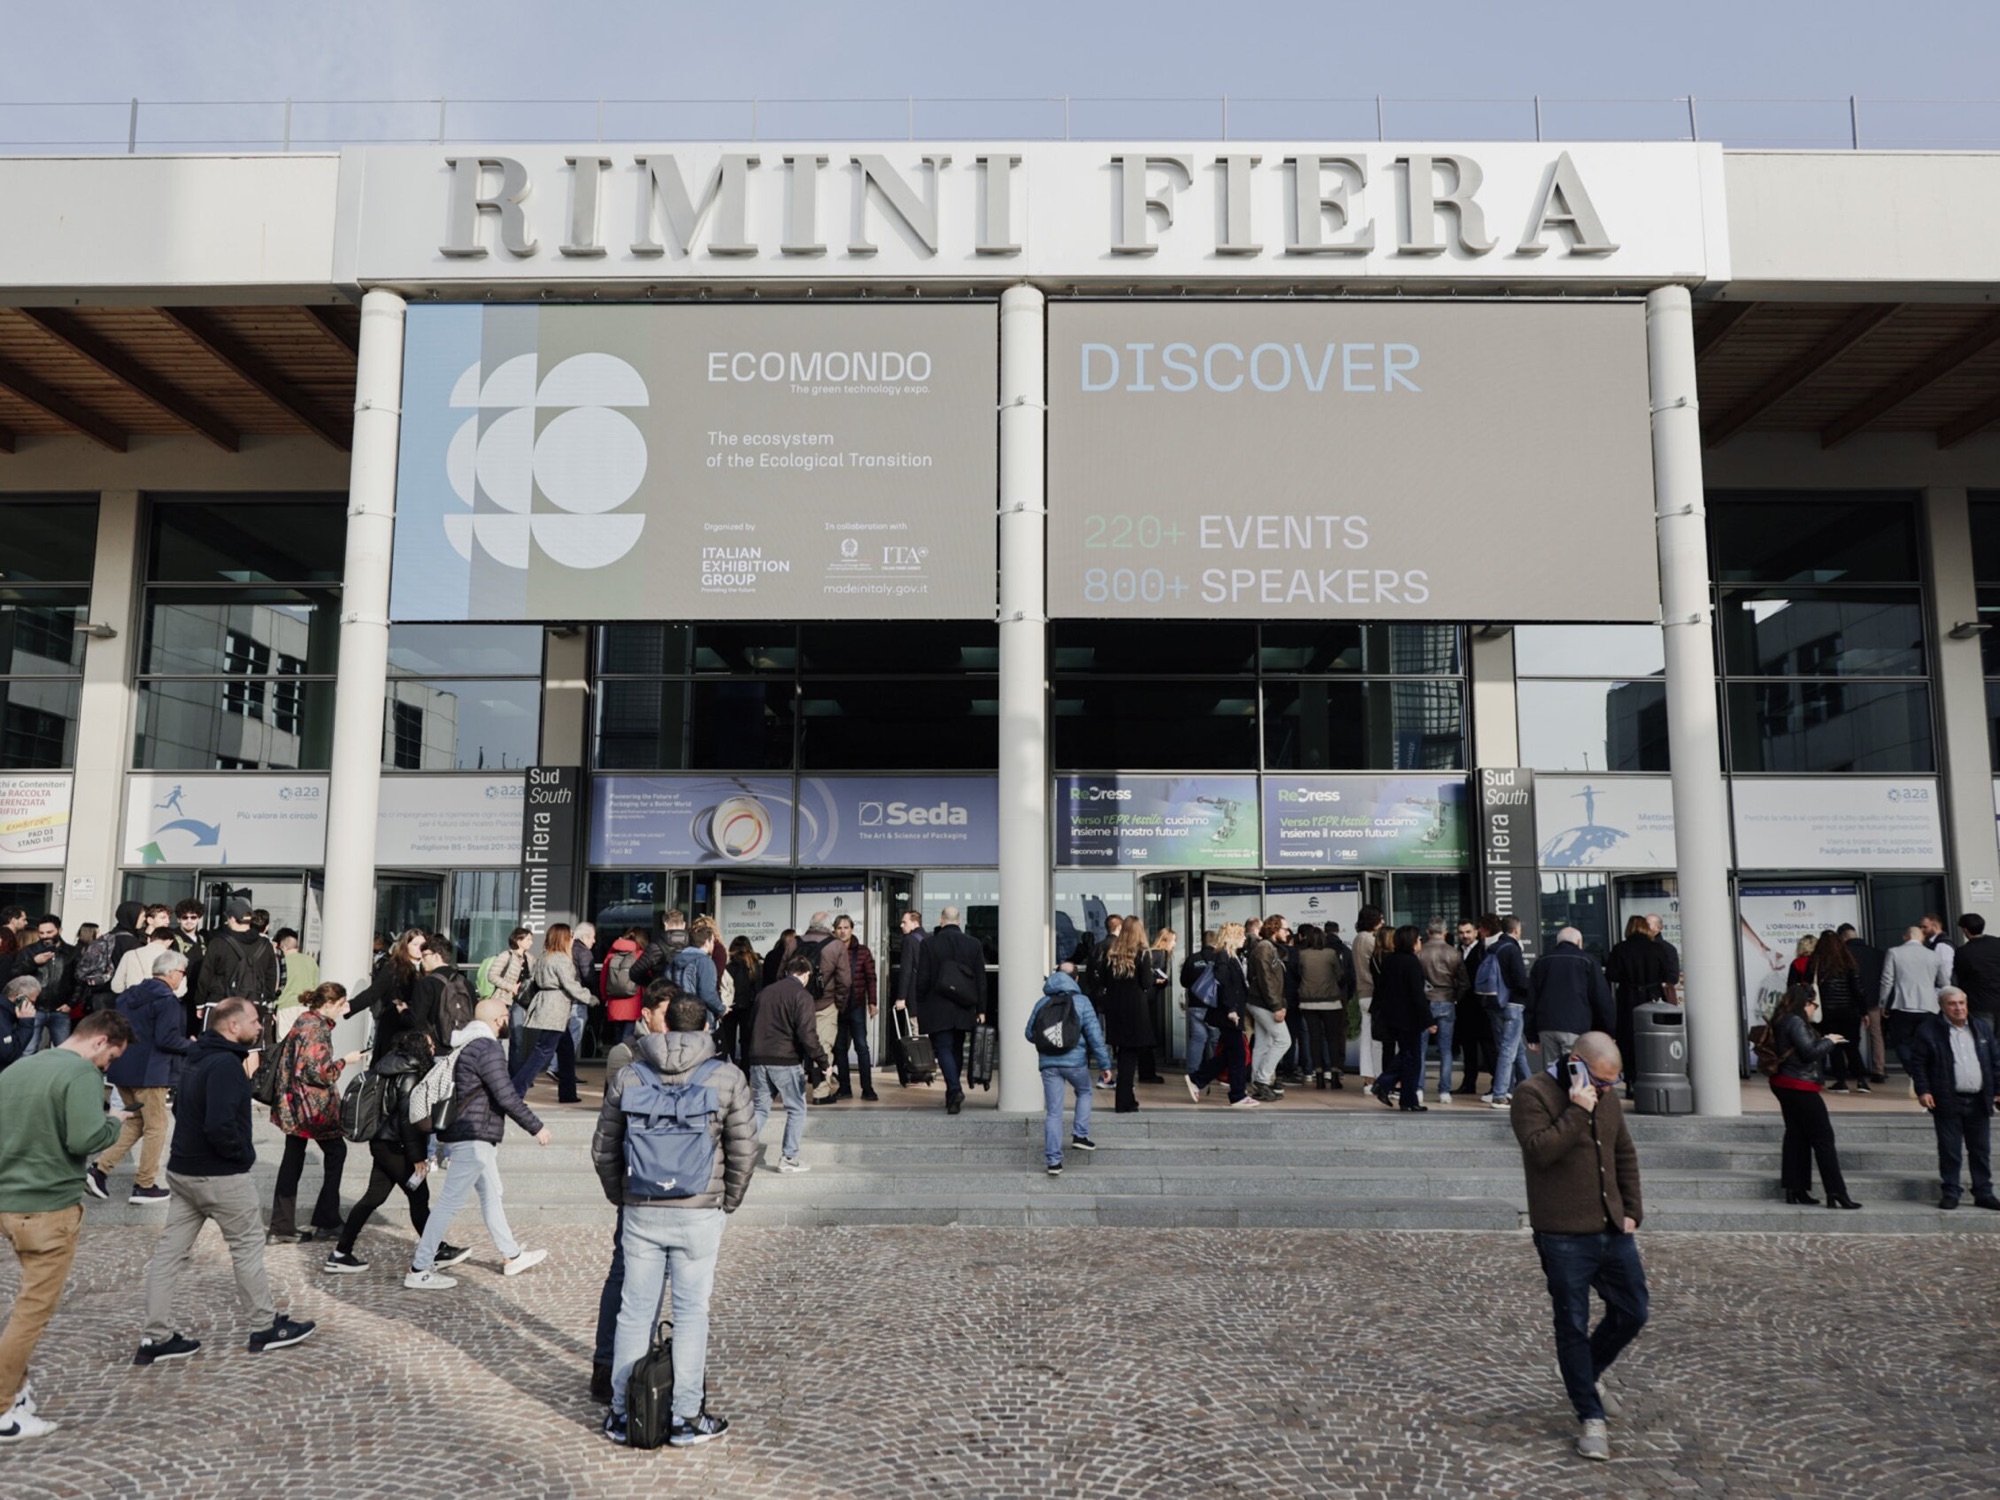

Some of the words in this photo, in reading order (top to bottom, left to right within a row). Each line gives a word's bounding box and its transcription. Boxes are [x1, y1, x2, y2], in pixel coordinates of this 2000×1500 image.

[439, 154, 1022, 258] RIMINI
[1109, 150, 1621, 257] FIERA
[708, 351, 931, 382] ECOMONDO
[1081, 342, 1422, 392] DISCOVER
[791, 384, 809, 394] The
[812, 386, 841, 396] green
[844, 384, 901, 397] technology
[904, 386, 931, 396] expo.
[707, 431, 738, 445] The
[743, 433, 834, 449] ecosystem
[706, 453, 722, 467] of
[727, 453, 754, 467] the
[760, 452, 844, 471] Ecological
[849, 452, 932, 467] Transition
[704, 523, 743, 532] Organized
[745, 523, 756, 532] by
[1084, 514, 1187, 549] 220+
[1199, 515, 1369, 549] EVENTS
[702, 547, 761, 559] ITALIAN
[882, 546, 921, 564] ITA
[702, 560, 790, 572] EXHIBITION
[701, 573, 756, 586] GROUP
[1084, 567, 1188, 603] 800+
[1201, 568, 1430, 604] SPEAKERS
[824, 584, 928, 596] madeinitaly.gov.it
[530, 768, 560, 784] Sud
[1484, 769, 1515, 786] Sud
[18, 780, 66, 789] Contenitori
[8, 789, 51, 798] RACCOLTA
[294, 786, 320, 797] a2a
[529, 787, 572, 804] South
[1485, 788, 1529, 805] South
[1903, 788, 1929, 799] a2a
[0, 807, 28, 815] RIFIUTI
[237, 811, 250, 820] Più
[253, 812, 278, 820] valore
[289, 812, 318, 820] circolo
[886, 801, 968, 826] Seda
[1071, 816, 1101, 826] Verso
[1164, 816, 1209, 826] cuciamo
[1280, 818, 1310, 828] Verso
[1373, 817, 1419, 827] cuciamo
[28, 829, 43, 838] PAD
[43, 828, 54, 836] D3
[525, 812, 551, 863] Fiera
[930, 832, 967, 841] Packaging
[1071, 826, 1112, 837] insieme
[1121, 827, 1154, 837] nostro
[1155, 826, 1189, 837] futuro!
[1280, 828, 1320, 838] insieme
[1330, 828, 1364, 838] nostro
[1365, 827, 1399, 839] futuro!
[17, 837, 41, 848] STAND
[43, 835, 54, 843] 101
[1487, 814, 1511, 865] Fiera
[410, 843, 450, 853] Padiglione
[467, 843, 489, 851] Stand
[1070, 848, 1106, 856] Reconomy
[1280, 850, 1316, 858] Reconomy
[1819, 847, 1860, 857] Padiglione
[1877, 847, 1900, 855] Stand
[1488, 870, 1513, 918] mini
[523, 868, 548, 934] Rimini
